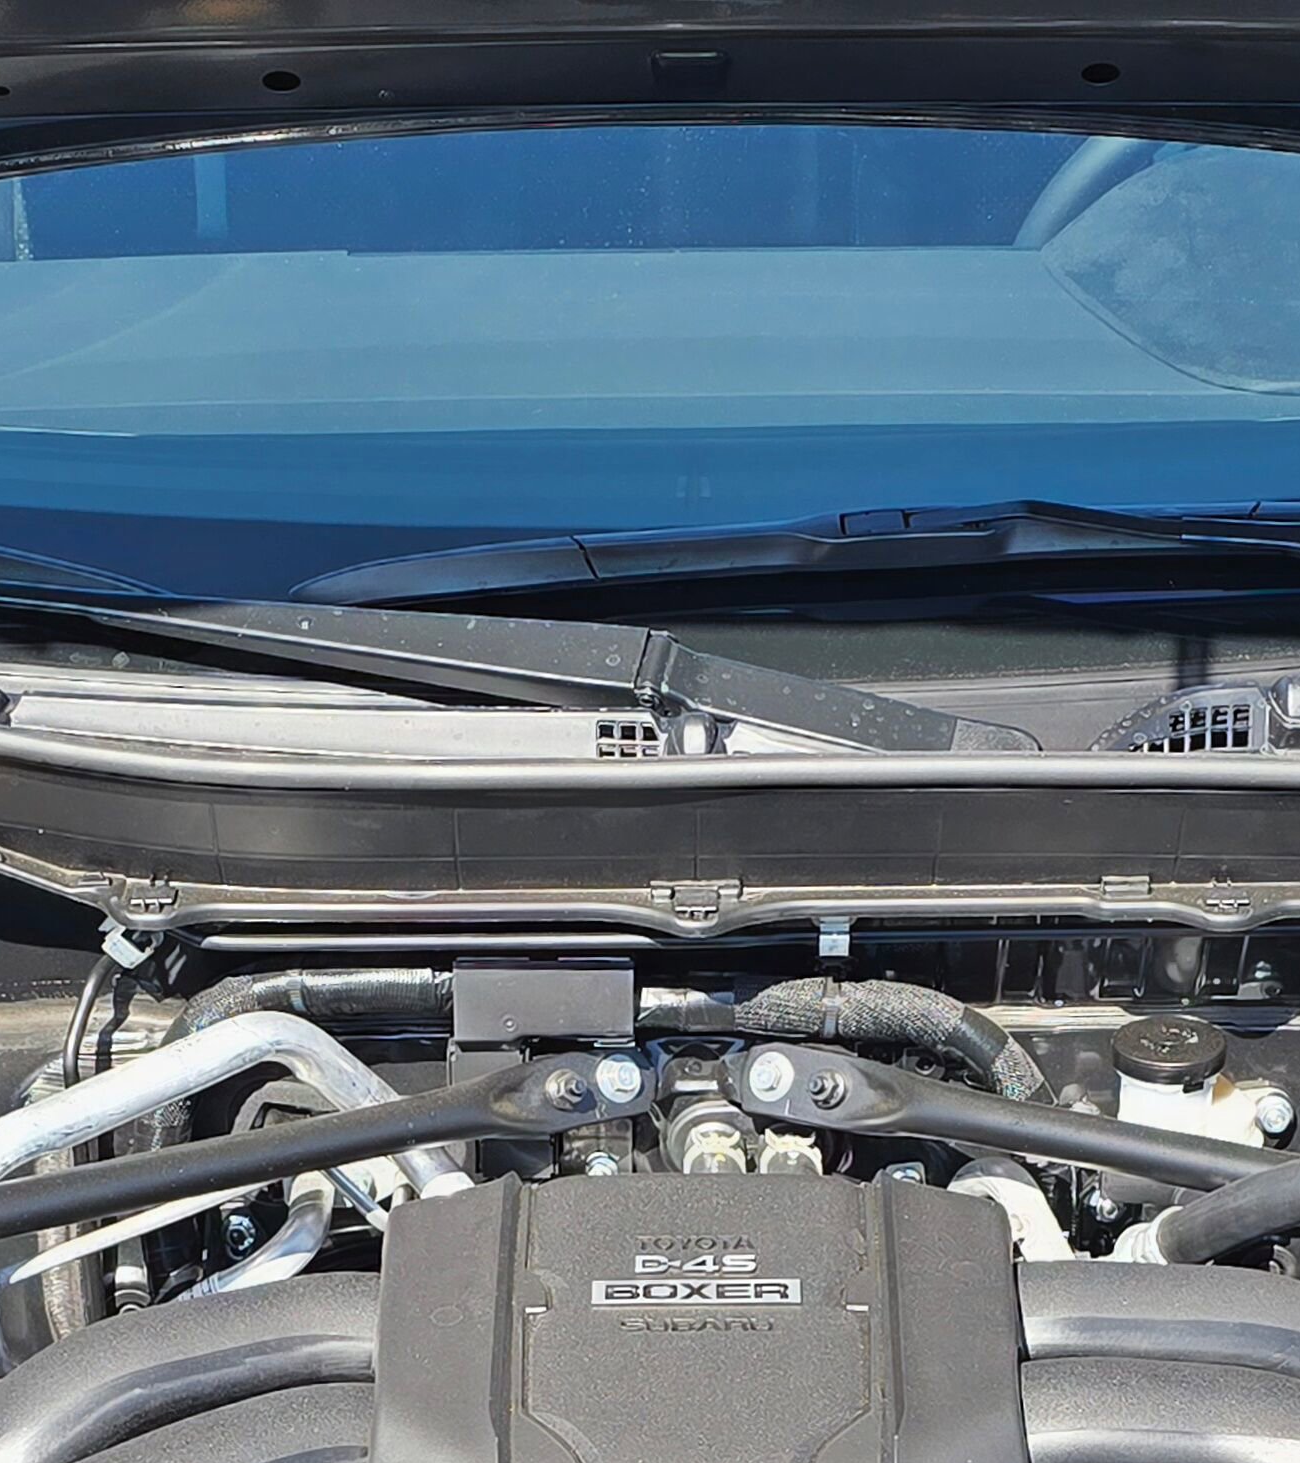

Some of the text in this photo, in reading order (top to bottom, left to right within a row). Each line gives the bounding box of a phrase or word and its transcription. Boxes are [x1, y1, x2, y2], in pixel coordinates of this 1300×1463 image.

[635, 1234, 756, 1250] TOYOTA
[634, 1254, 757, 1274] D-4S
[604, 1283, 789, 1300] BOXER
[619, 1316, 776, 1332] SUBARU
